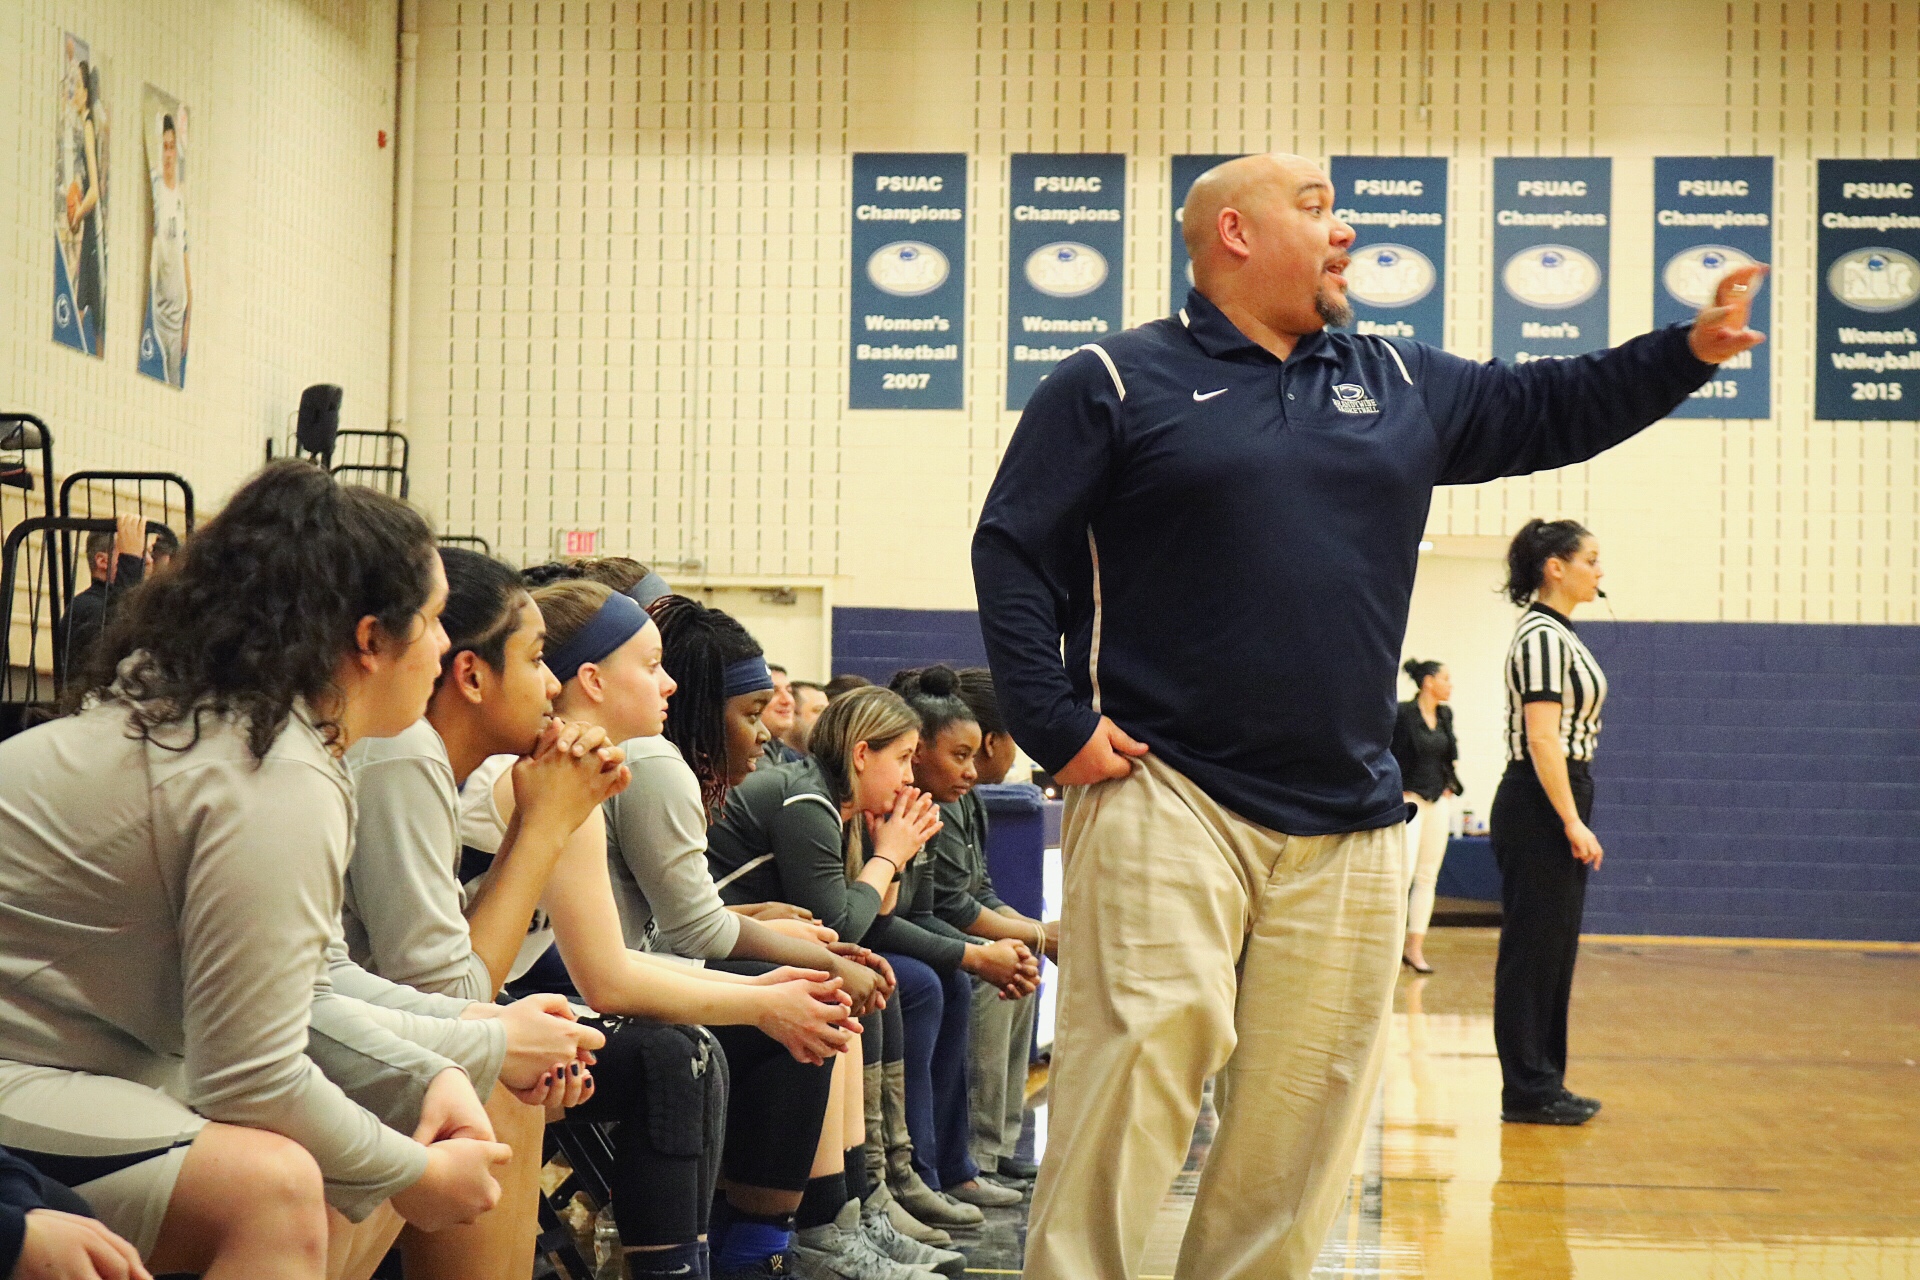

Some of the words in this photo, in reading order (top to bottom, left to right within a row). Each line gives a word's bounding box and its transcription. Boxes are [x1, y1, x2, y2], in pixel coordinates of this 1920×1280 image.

[877, 176, 943, 191] PSUAC
[1034, 176, 1101, 192] PSUAC
[1354, 179, 1423, 196] PSUAC
[1518, 181, 1587, 197] PSUAC
[1678, 180, 1748, 197] PSUAC
[1843, 183, 1913, 199] PSUAC
[856, 205, 962, 223] Champions
[1014, 206, 1120, 223] Champions
[1334, 208, 1443, 228] Champions
[1497, 210, 1607, 228] Champions
[1658, 210, 1769, 228] Champions
[1822, 212, 1920, 231] Champion
[865, 315, 949, 331] Women's
[1022, 316, 1108, 332] Women's
[1357, 320, 1414, 337] Men's
[1522, 322, 1579, 339] Men's
[1838, 327, 1917, 344] Women's
[856, 345, 957, 361] Basketball
[1014, 345, 1078, 361] Baske
[1831, 350, 1920, 373] Volleyball
[882, 373, 931, 389] 2007
[1851, 383, 1902, 400] 2015
[567, 531, 596, 554] EXIT
